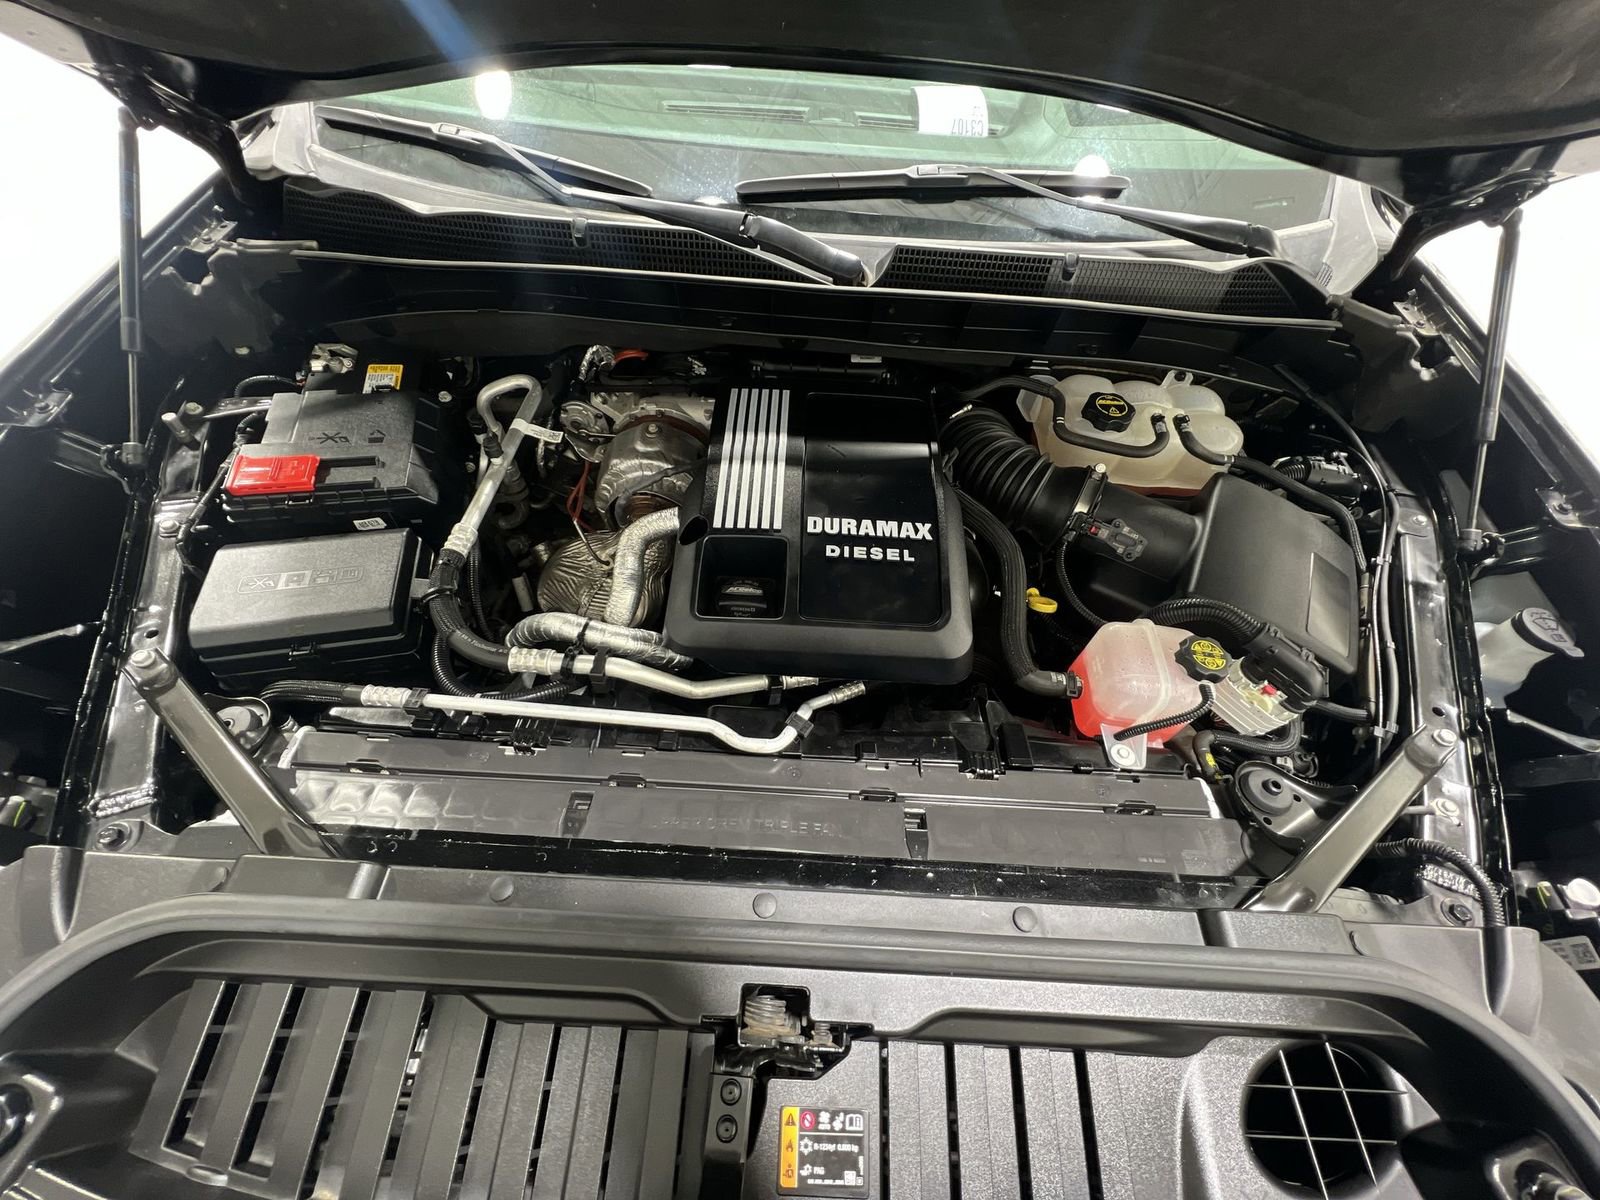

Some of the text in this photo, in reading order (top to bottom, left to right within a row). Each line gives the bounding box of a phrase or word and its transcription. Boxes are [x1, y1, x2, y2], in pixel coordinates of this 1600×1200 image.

[951, 119, 984, 137] C3107
[806, 516, 933, 540] DURAMAX
[825, 544, 915, 562] DIESEL
